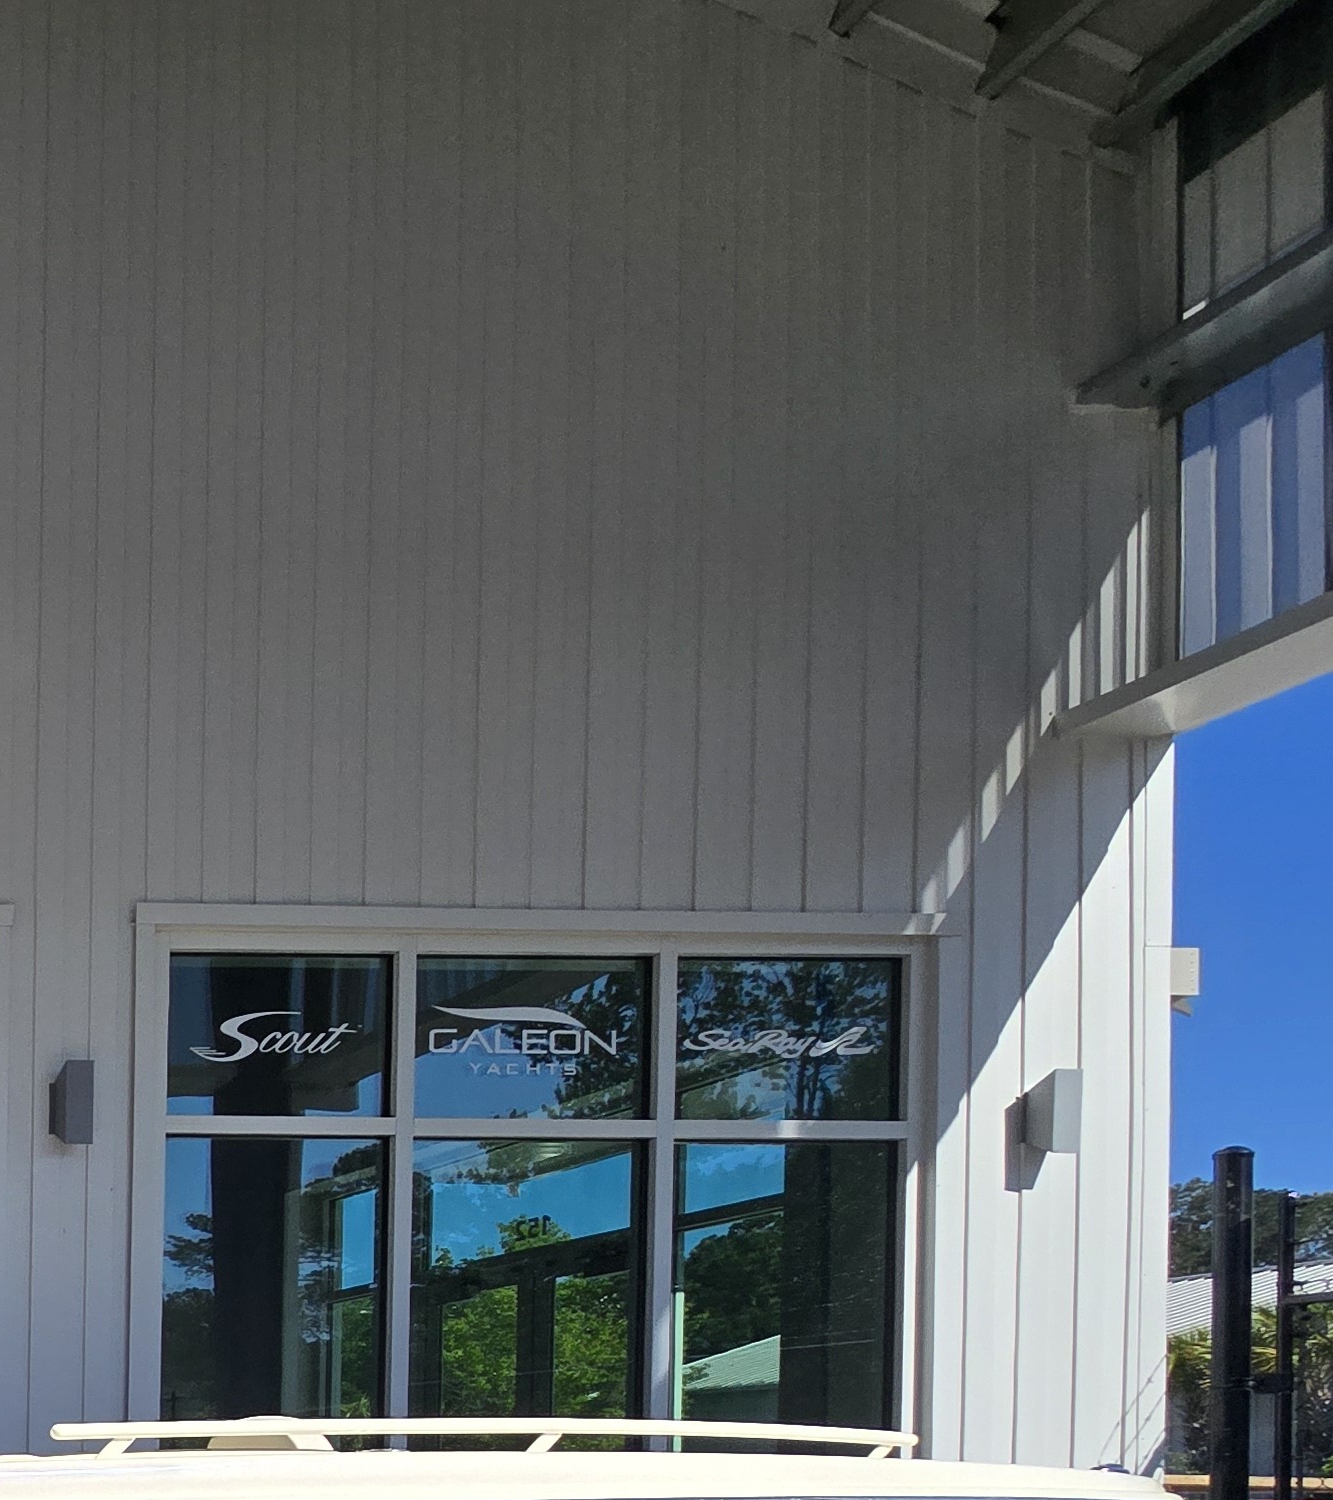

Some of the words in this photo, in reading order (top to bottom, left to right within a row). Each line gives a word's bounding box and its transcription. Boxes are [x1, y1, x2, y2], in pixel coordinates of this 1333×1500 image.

[189, 1011, 357, 1062] Scout
[428, 1028, 617, 1055] GALEON
[469, 1062, 577, 1076] YACHTS
